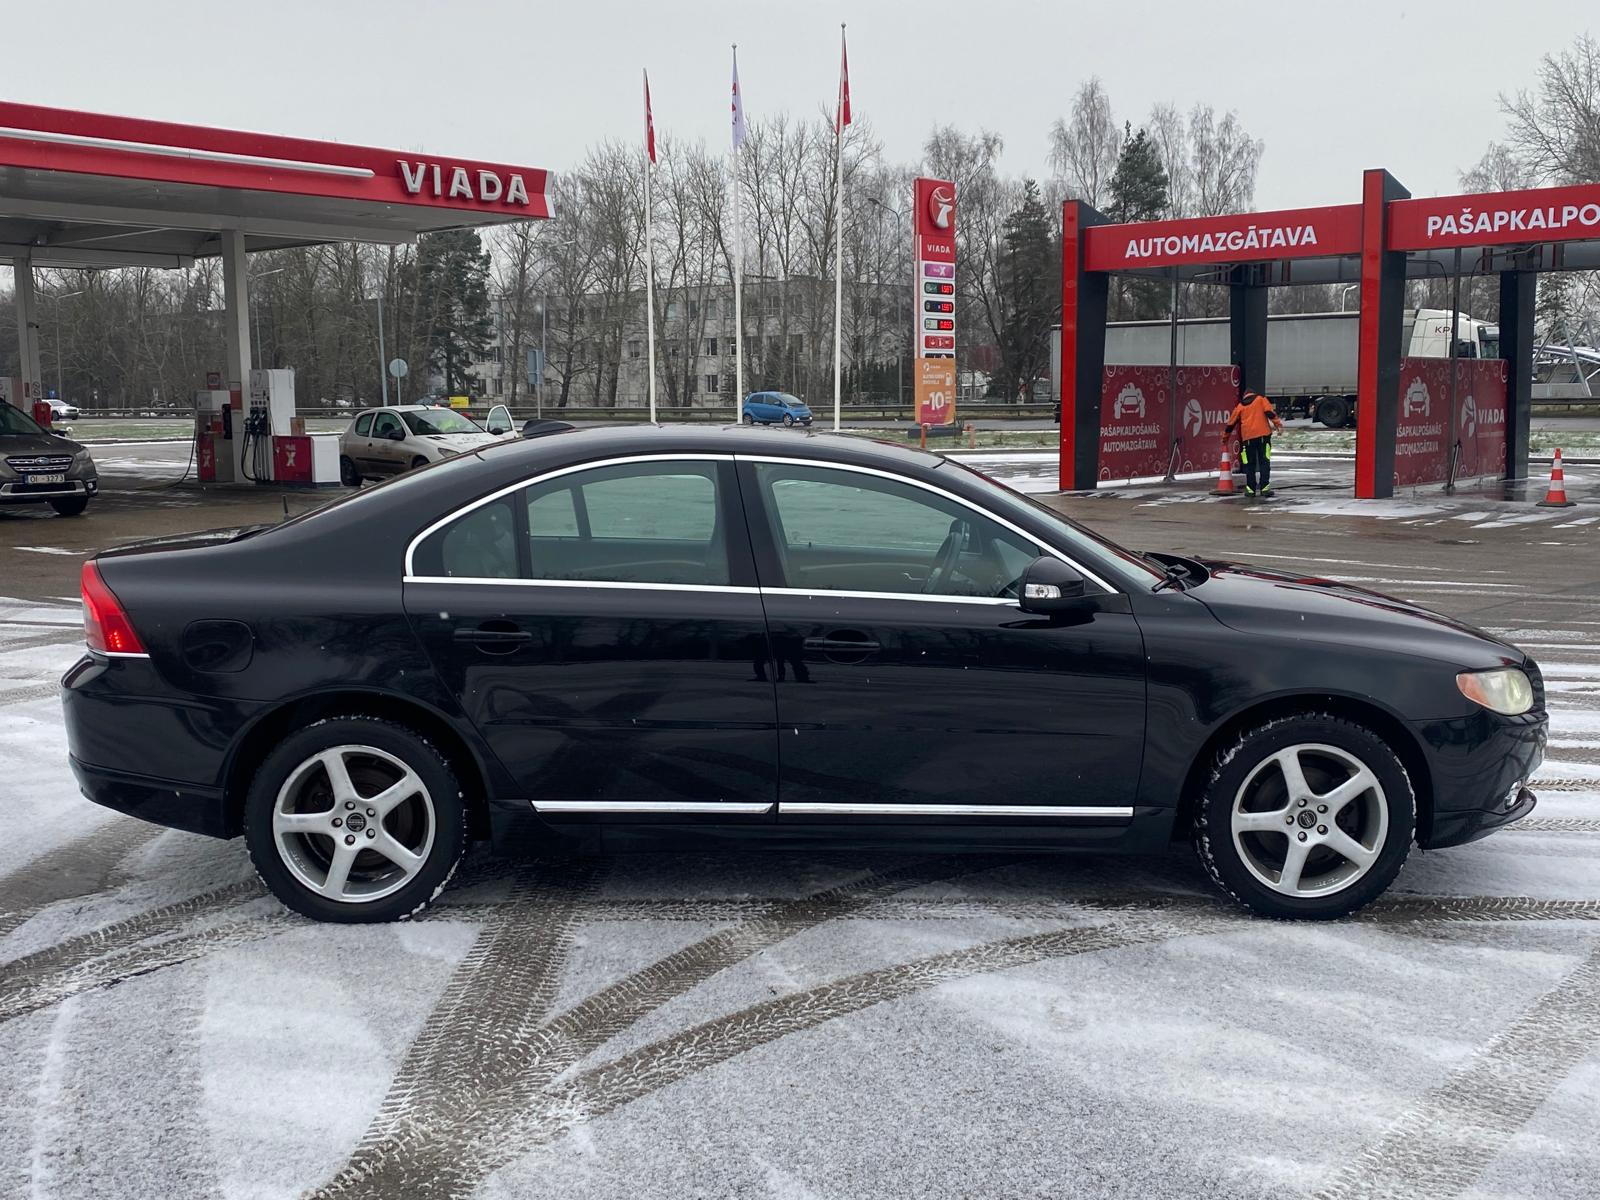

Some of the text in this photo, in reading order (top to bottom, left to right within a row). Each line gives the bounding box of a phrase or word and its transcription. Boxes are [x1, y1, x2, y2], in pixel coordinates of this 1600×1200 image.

[397, 160, 529, 204] VIADA
[1427, 203, 1600, 239] PAŠAPKALPO
[927, 244, 951, 254] VIADA
[1125, 225, 1318, 258] AUTOMAZGĀTAVA
[1204, 410, 1231, 425] VIAD
[1478, 408, 1504, 423] VIADA
[1103, 438, 1157, 453] AUTOMAZGĀTAVA
